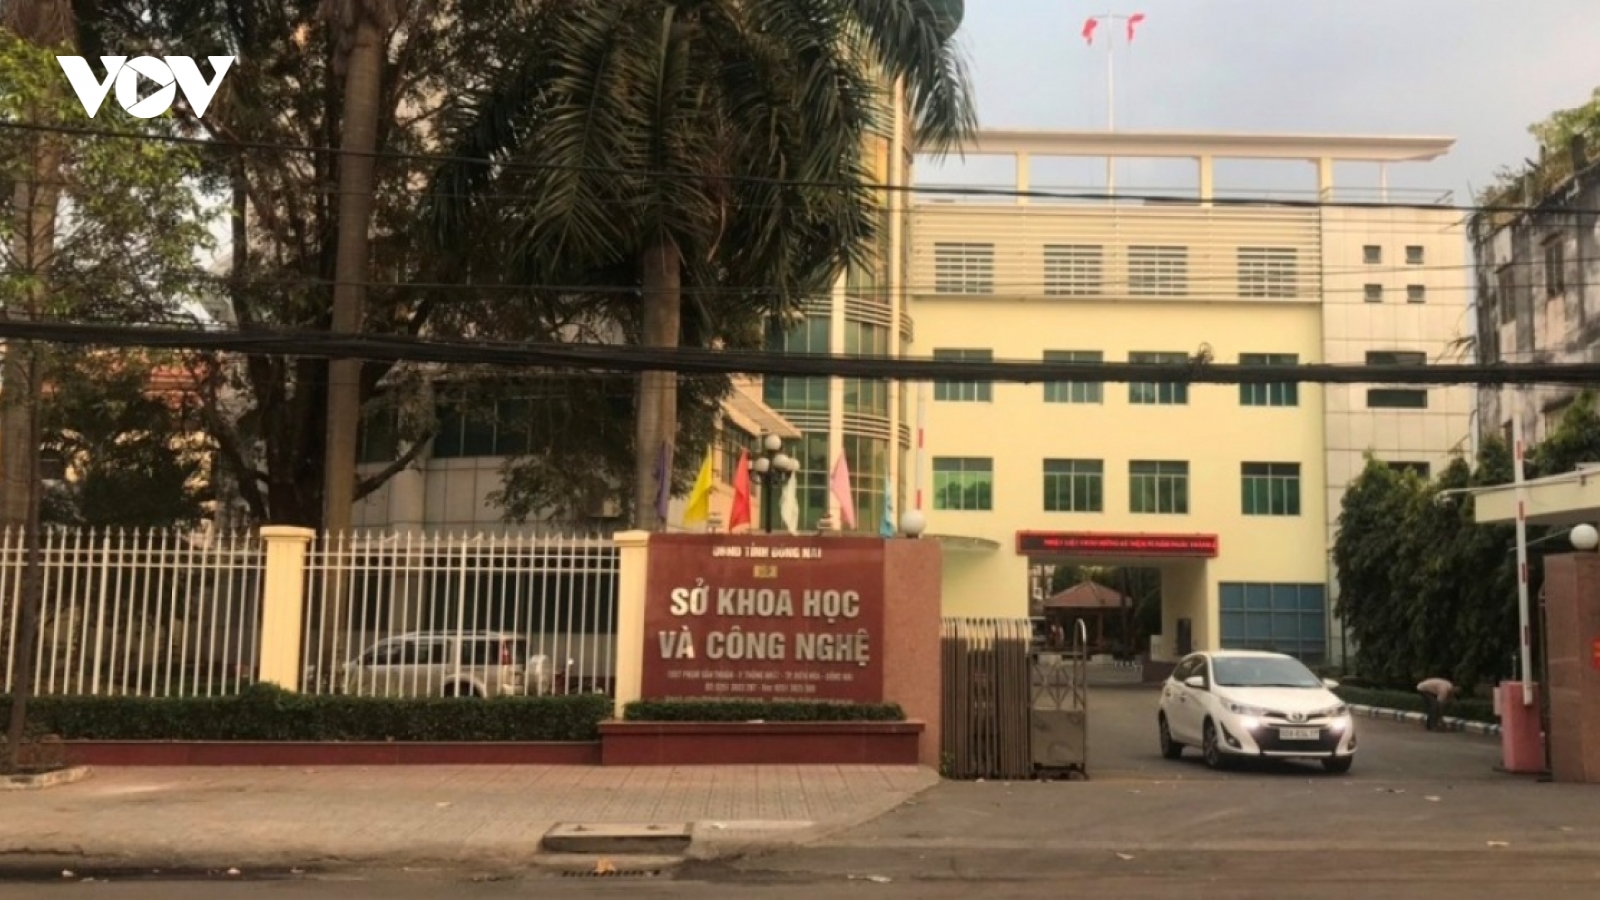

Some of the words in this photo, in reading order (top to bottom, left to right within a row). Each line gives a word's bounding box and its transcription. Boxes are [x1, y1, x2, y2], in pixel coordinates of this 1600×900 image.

[670, 577, 709, 617] SỞ
[717, 588, 793, 617] KHOA
[803, 590, 860, 624] HỌC
[658, 625, 695, 659] VÀ
[706, 625, 786, 659] CÔNG
[795, 628, 870, 666] NGHỆ
